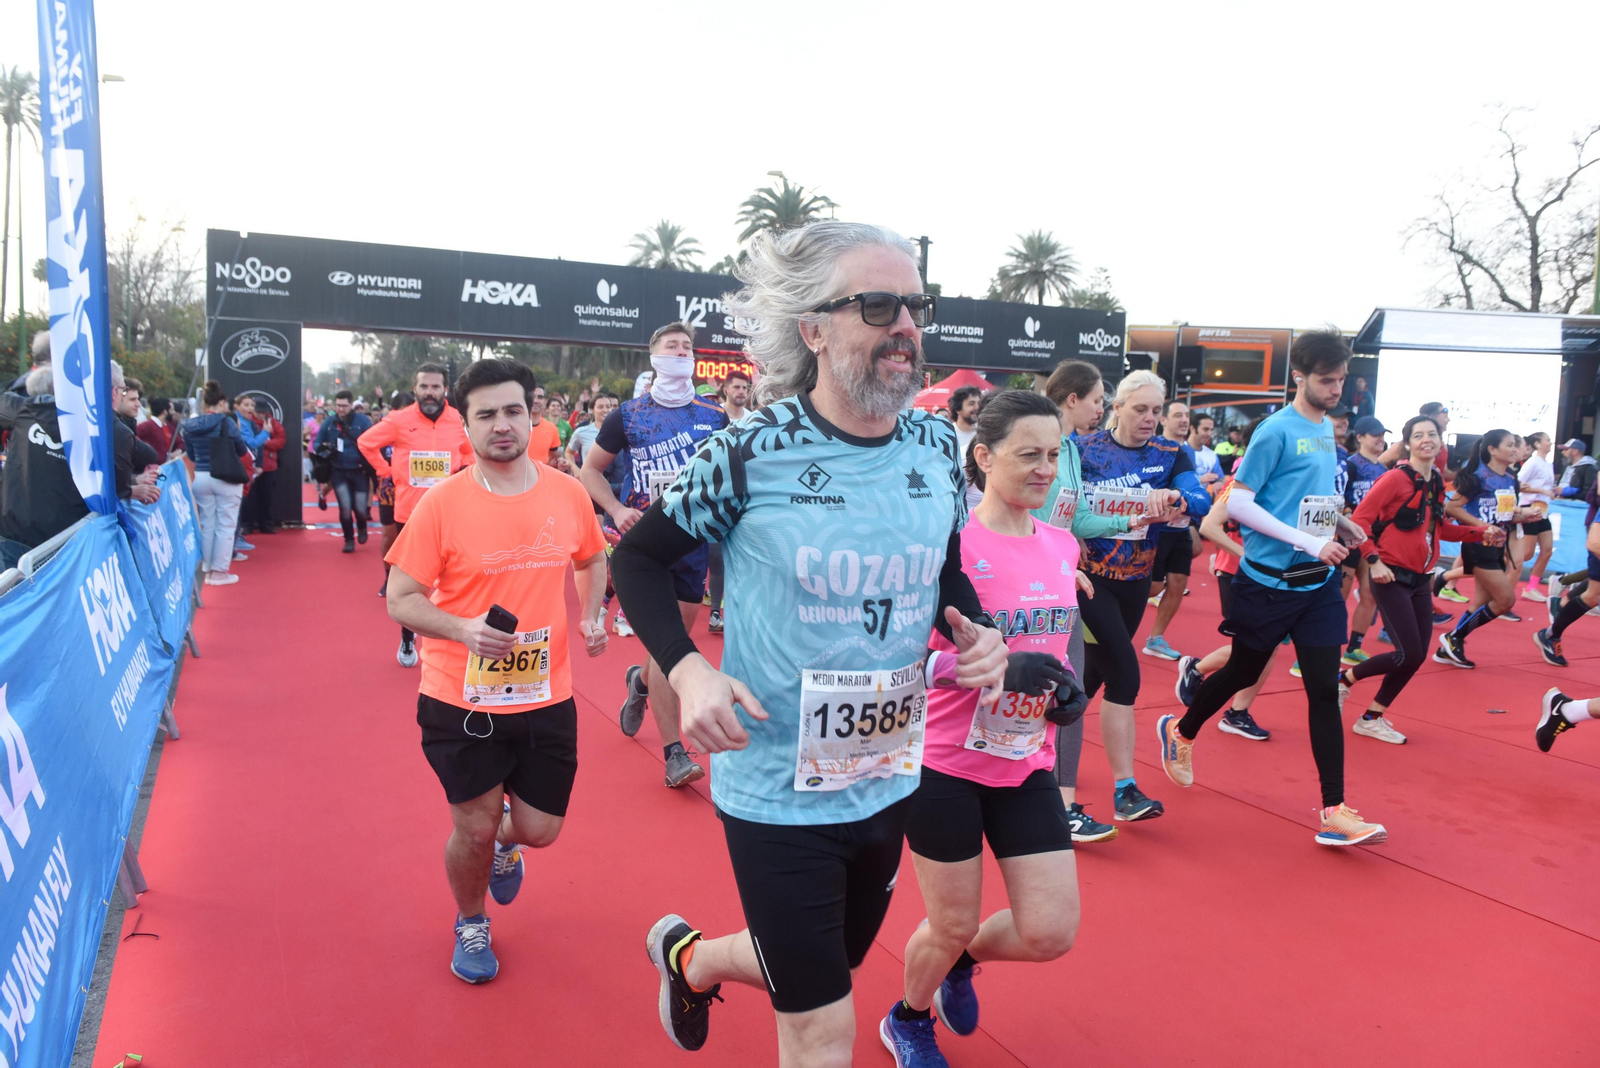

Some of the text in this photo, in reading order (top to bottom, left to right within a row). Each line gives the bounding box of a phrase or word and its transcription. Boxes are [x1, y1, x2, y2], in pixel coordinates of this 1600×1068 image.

[357, 274, 422, 290] HYUNDAI
[357, 287, 421, 300] Hyundauto Motor
[461, 279, 539, 307] HOKA
[579, 318, 633, 328] Healthcare Partner
[941, 325, 984, 336] HYUNDAI
[711, 334, 723, 343] 28
[648, 432, 693, 459] MARATÓN
[413, 461, 445, 471] 11508
[1142, 465, 1164, 473] HOKA
[790, 496, 846, 505] FORTUNA
[908, 491, 933, 499] luanvi
[1098, 499, 1144, 516] 14479
[483, 568, 497, 576] Viu
[796, 544, 941, 601] GOZATU
[896, 591, 920, 610] SAN
[80, 551, 137, 677] HOKA
[863, 598, 893, 641] 57
[524, 630, 543, 643] SEVILLA
[812, 675, 836, 687] MEDIO
[837, 672, 873, 688] MARATÓN
[990, 691, 1055, 720] 1358
[813, 694, 914, 739] 13585
[0, 833, 73, 1064] HUMAN FLY
